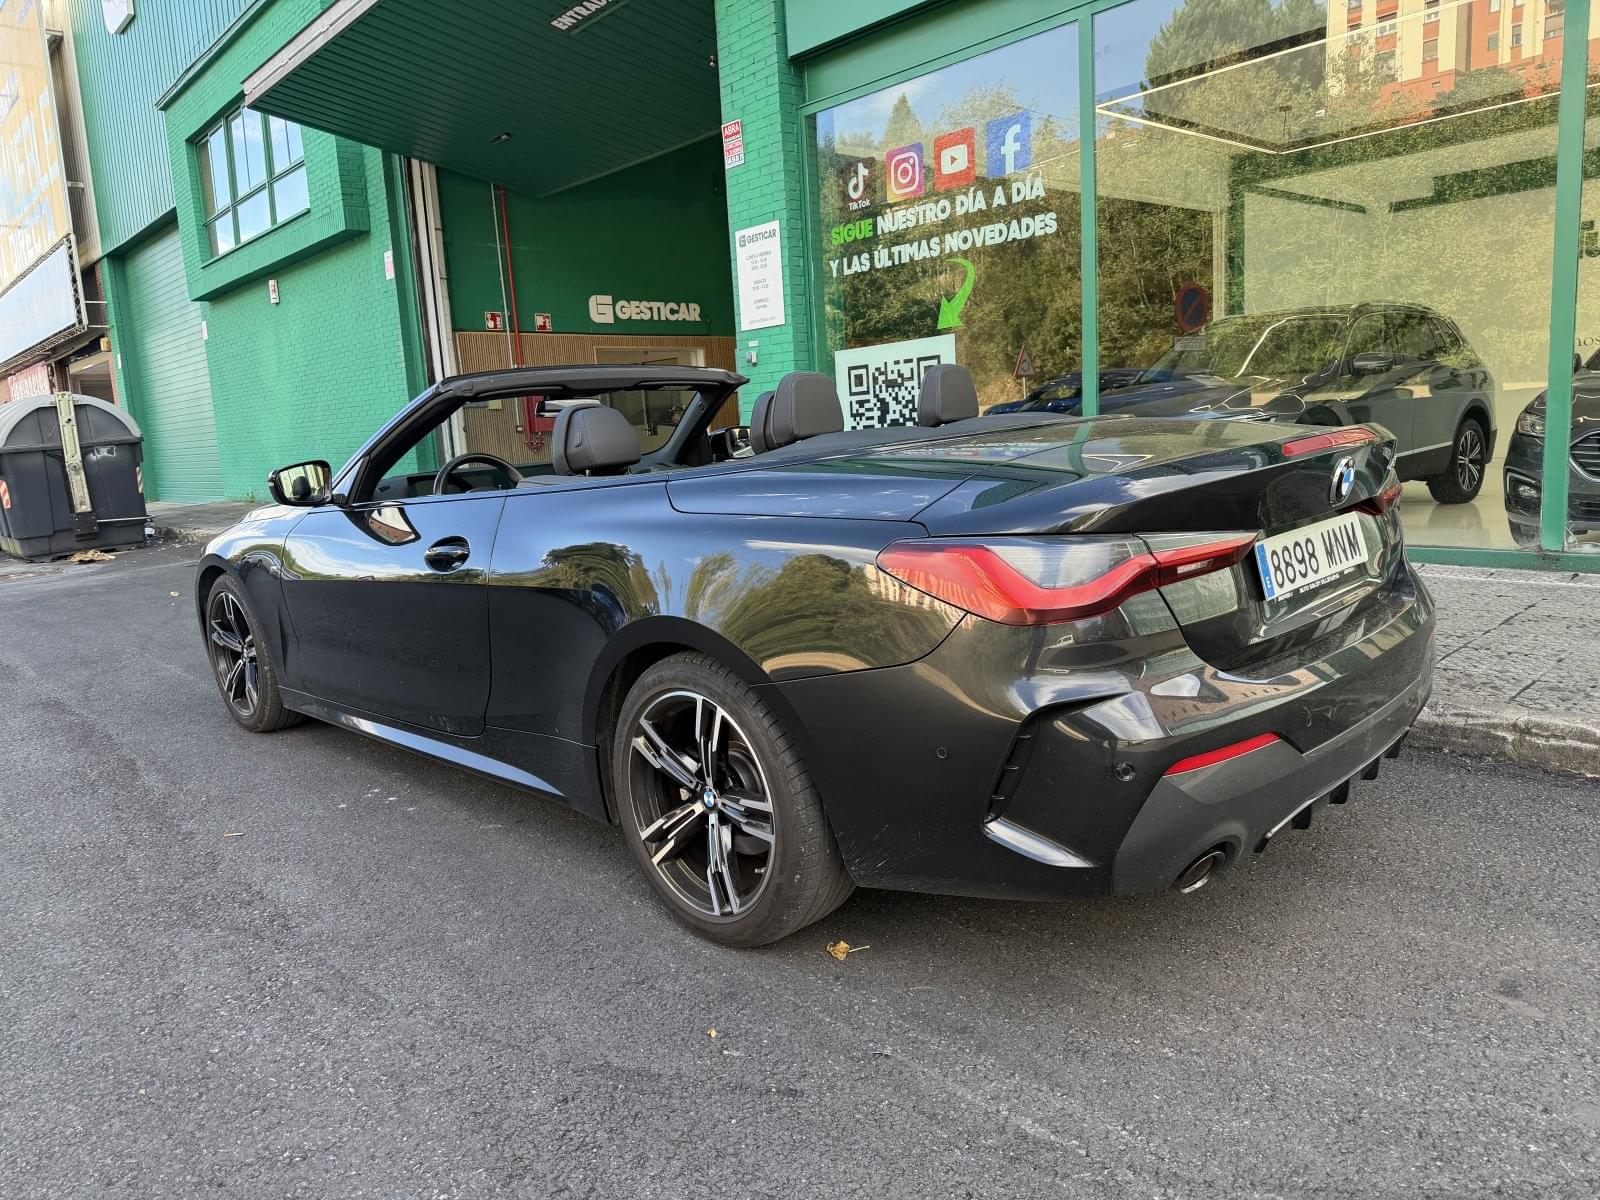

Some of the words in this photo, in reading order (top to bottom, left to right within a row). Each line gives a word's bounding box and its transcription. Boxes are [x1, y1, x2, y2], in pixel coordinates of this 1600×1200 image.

[831, 218, 874, 246] SIGUE
[876, 199, 951, 236] NUESTRO
[955, 186, 987, 215] DÍA
[992, 185, 1007, 208] A
[1011, 172, 1046, 203] DÍA
[848, 199, 871, 211] TikTok
[747, 228, 777, 244] GESTICAR
[829, 259, 840, 278] Y
[843, 252, 871, 276] LAS
[874, 236, 941, 269] ÚLTIMAS
[944, 212, 1058, 253] NOVEDADES
[615, 299, 702, 322] GESTICAR
[1270, 537, 1320, 589] 8898
[1321, 521, 1362, 569] MNM
